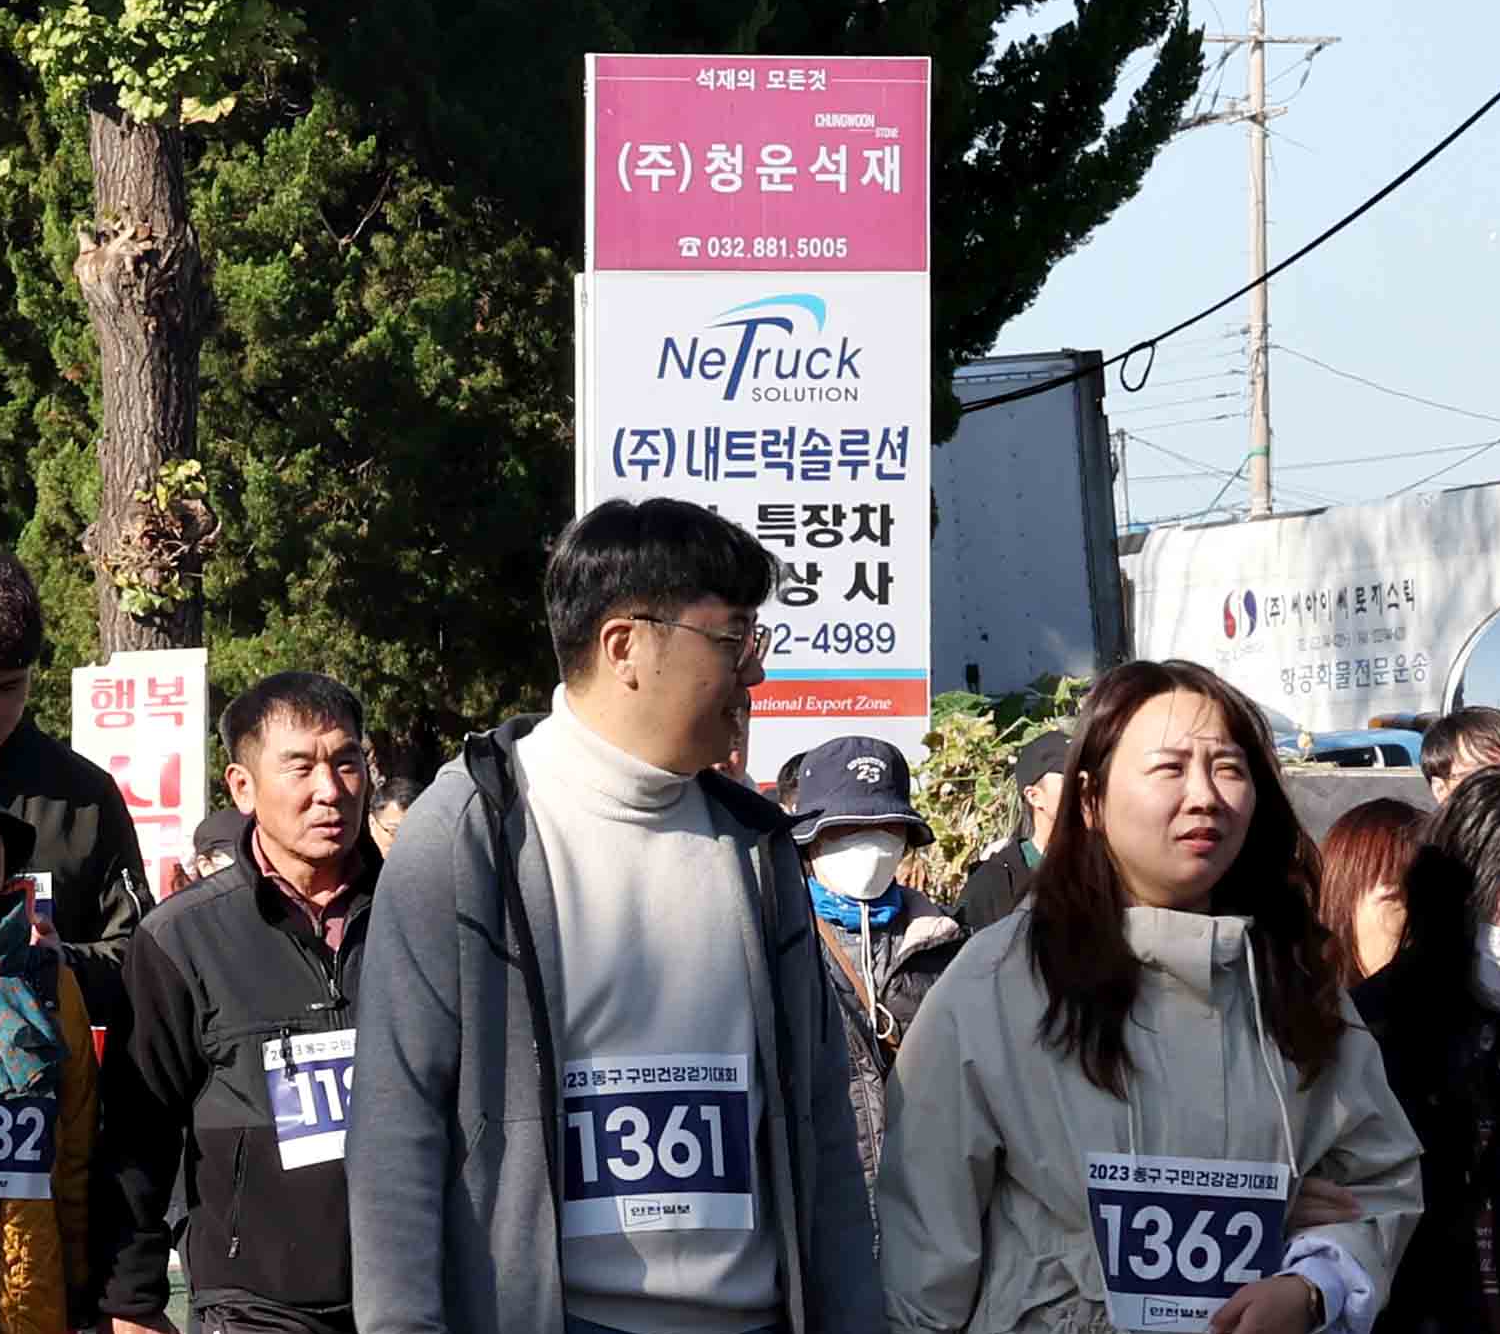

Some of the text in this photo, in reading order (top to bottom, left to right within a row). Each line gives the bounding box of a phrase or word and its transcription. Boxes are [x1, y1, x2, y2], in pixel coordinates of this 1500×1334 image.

[695, 68, 828, 92] 석재의 모든것
[707, 237, 848, 258] 032.881.5005
[752, 387, 858, 403] SOLUTION
[91, 676, 189, 729] 행복
[806, 696, 852, 713] Export
[855, 696, 893, 711] Zone
[592, 1068, 622, 1086] 동구
[626, 1066, 738, 1084] 구민건강걷기대회
[290, 1066, 355, 1126] 11
[567, 1105, 726, 1184] 1361
[1089, 1163, 1278, 1190] 2023 동구 구민건강걷기대회
[1099, 1203, 1264, 1284] 1362
